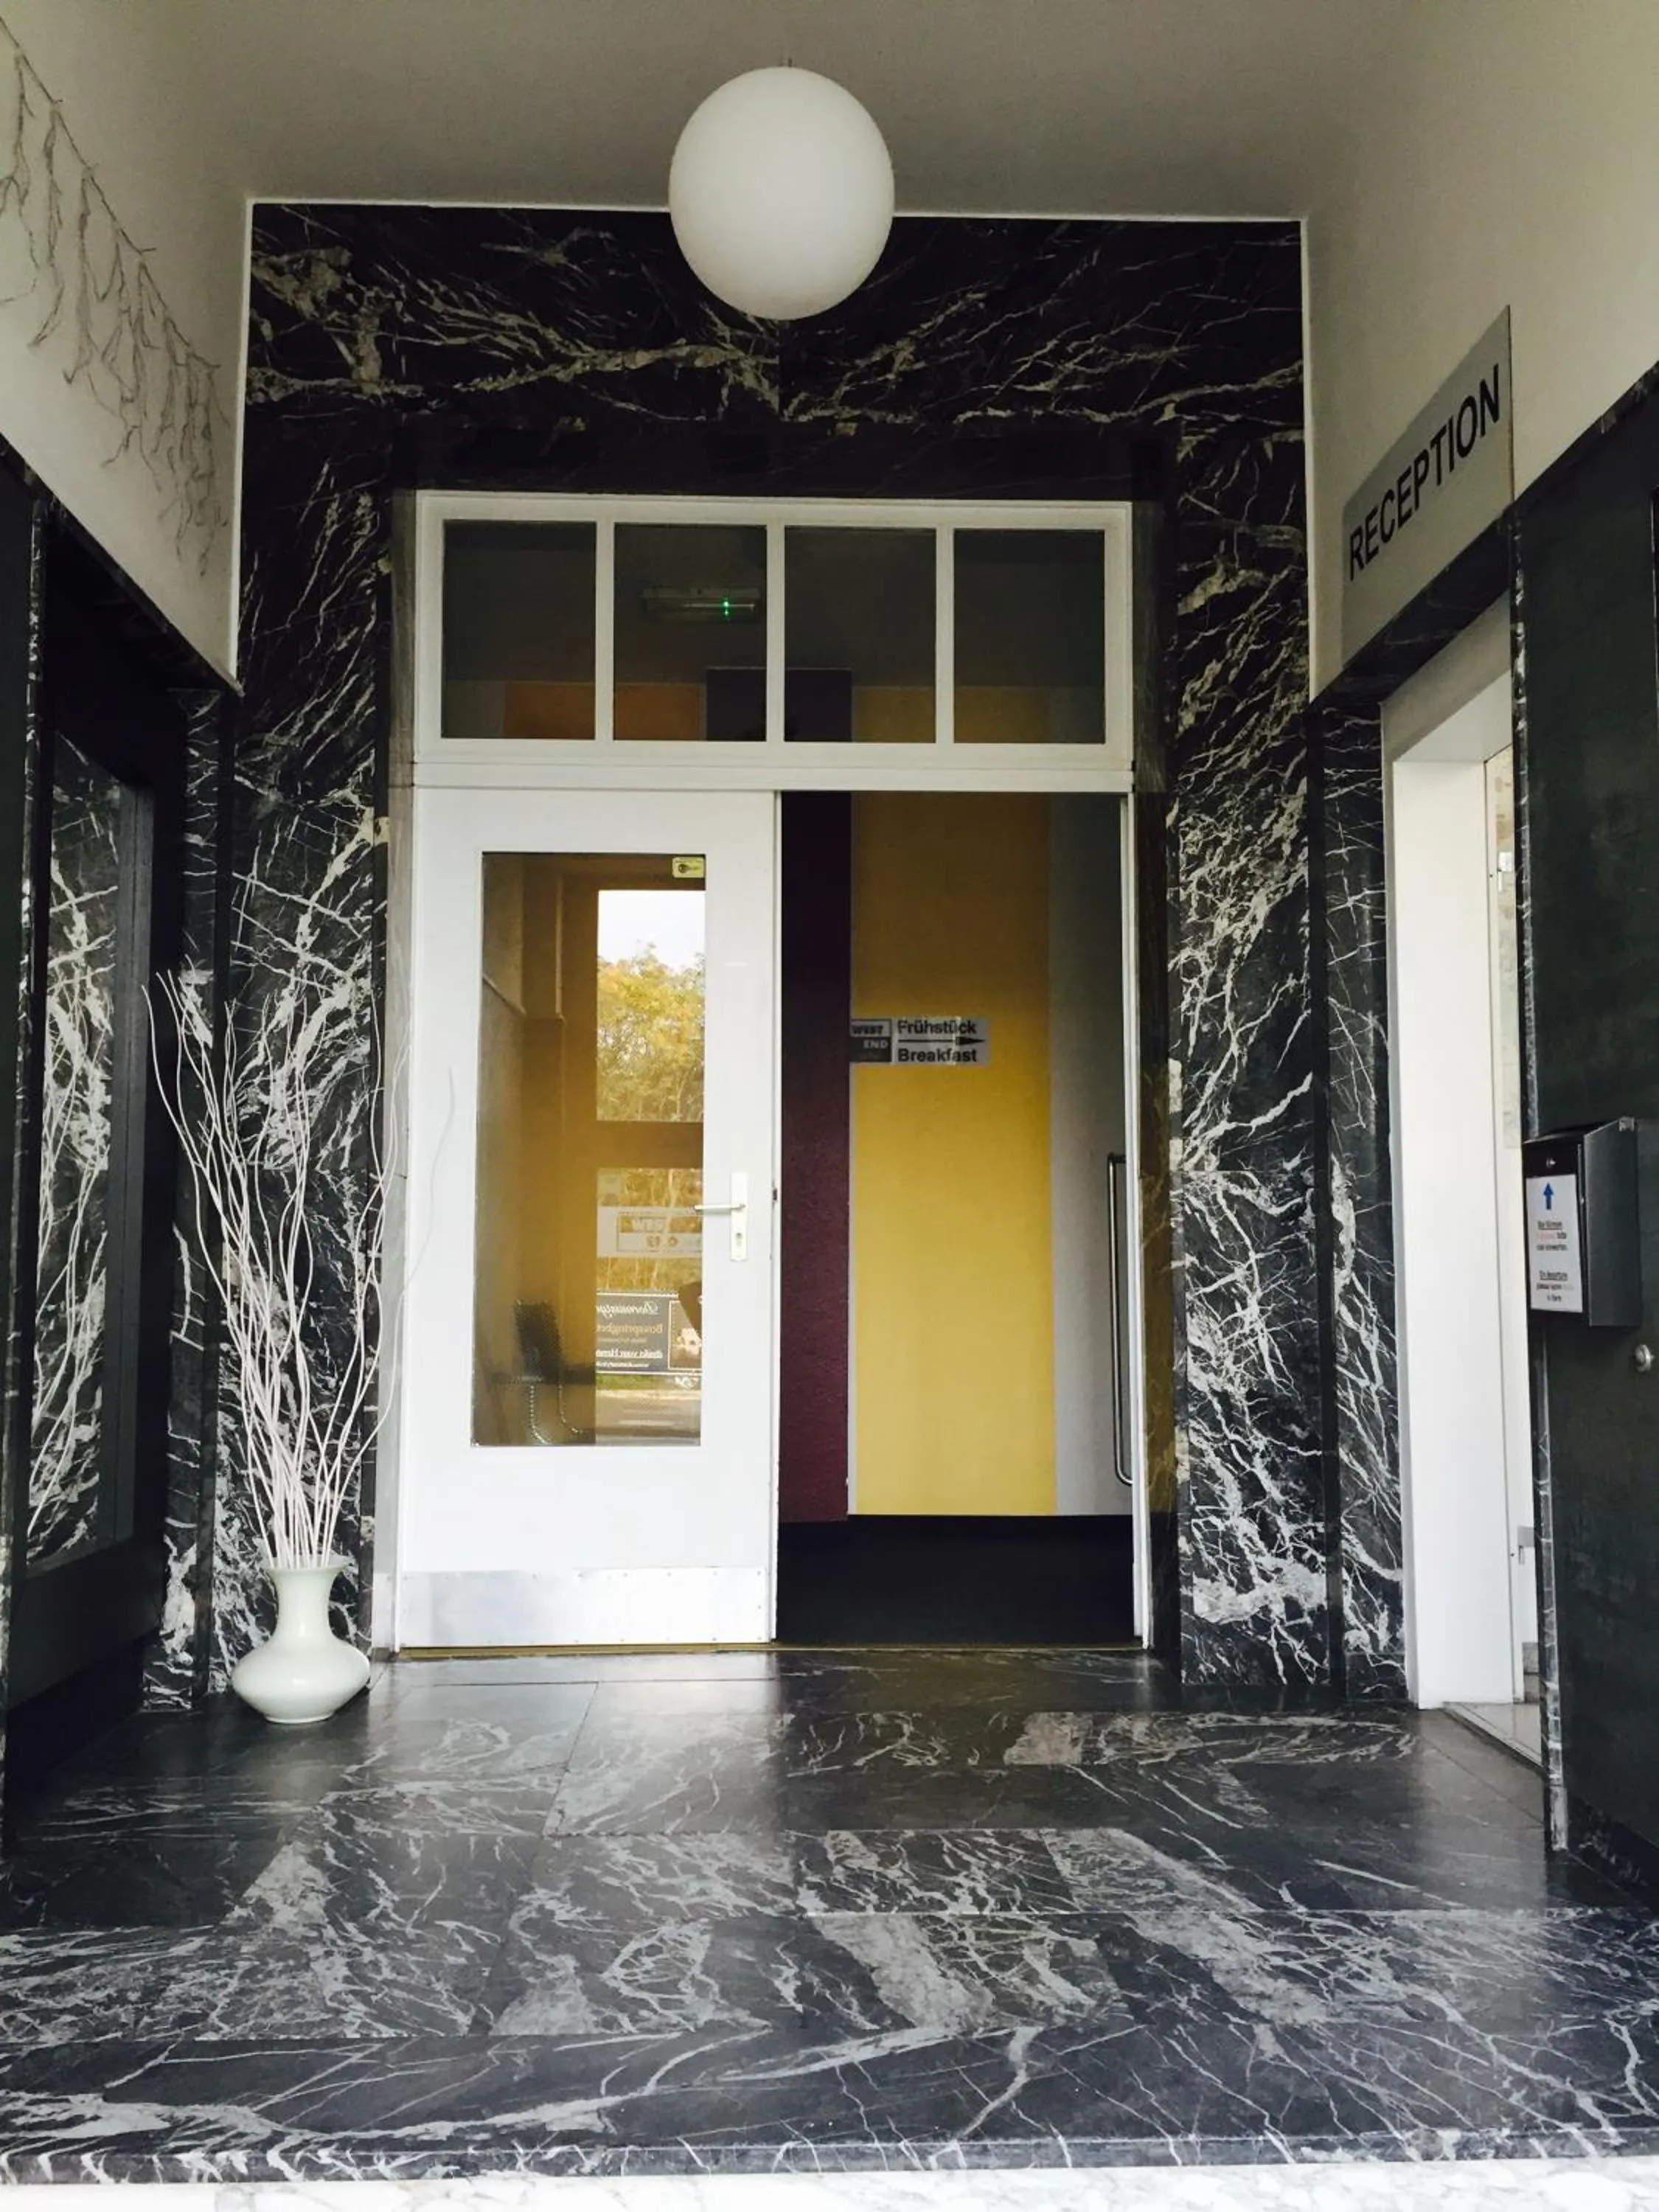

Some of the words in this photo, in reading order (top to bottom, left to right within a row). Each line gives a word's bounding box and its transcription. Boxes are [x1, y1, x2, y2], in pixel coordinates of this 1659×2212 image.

[1349, 363, 1500, 582] RECEPTION
[852, 1025, 883, 1034] WEST
[897, 1020, 977, 1034] Frühstück
[863, 1040, 888, 1048] END
[897, 1048, 977, 1062] Breakfast
